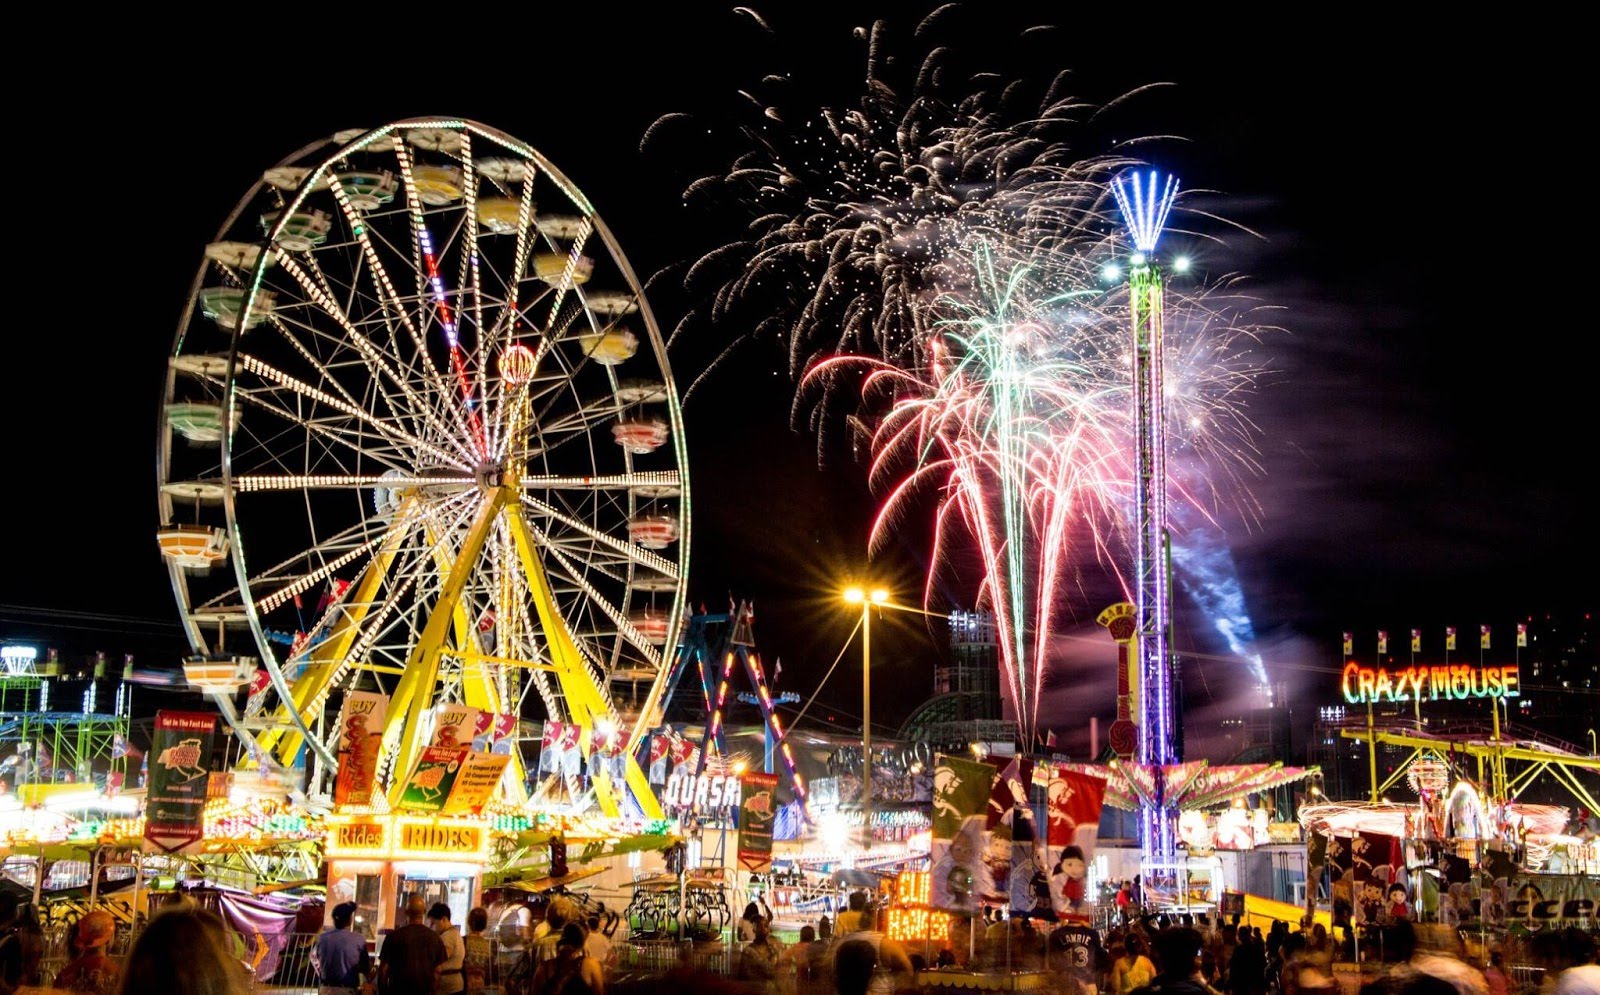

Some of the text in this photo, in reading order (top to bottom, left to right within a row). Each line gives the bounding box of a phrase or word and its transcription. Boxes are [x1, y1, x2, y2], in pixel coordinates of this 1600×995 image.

[1342, 662, 1521, 703] CRAZY MOUSE
[349, 700, 376, 714] BUY
[441, 712, 467, 726] BUY
[339, 825, 381, 848] Rides
[408, 825, 472, 850] RIDES
[1060, 933, 1092, 946] LAWRIE
[1064, 946, 1089, 968] 13
